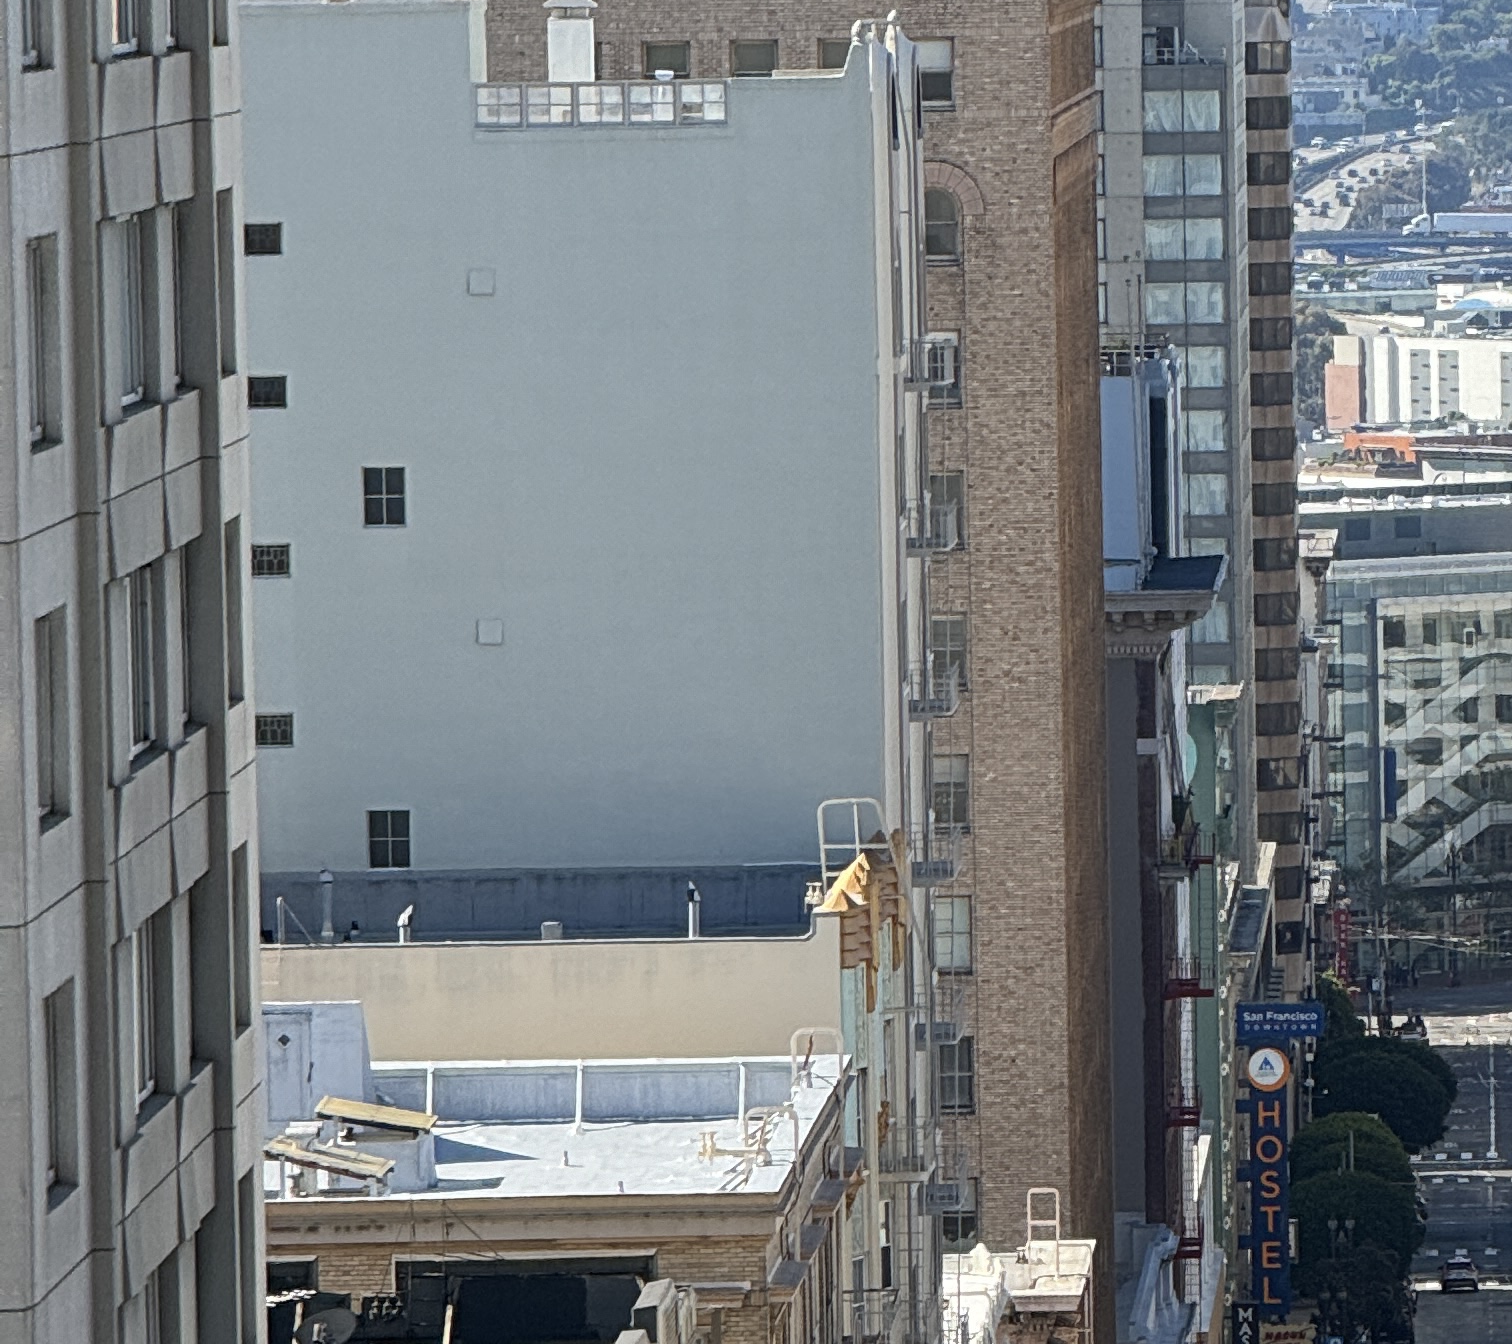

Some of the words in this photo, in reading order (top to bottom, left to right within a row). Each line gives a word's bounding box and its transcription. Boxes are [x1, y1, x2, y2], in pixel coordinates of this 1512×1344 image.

[1243, 1012, 1263, 1021] San
[1266, 1011, 1318, 1021] Francisco
[1255, 1100, 1284, 1304] HOSTEL
